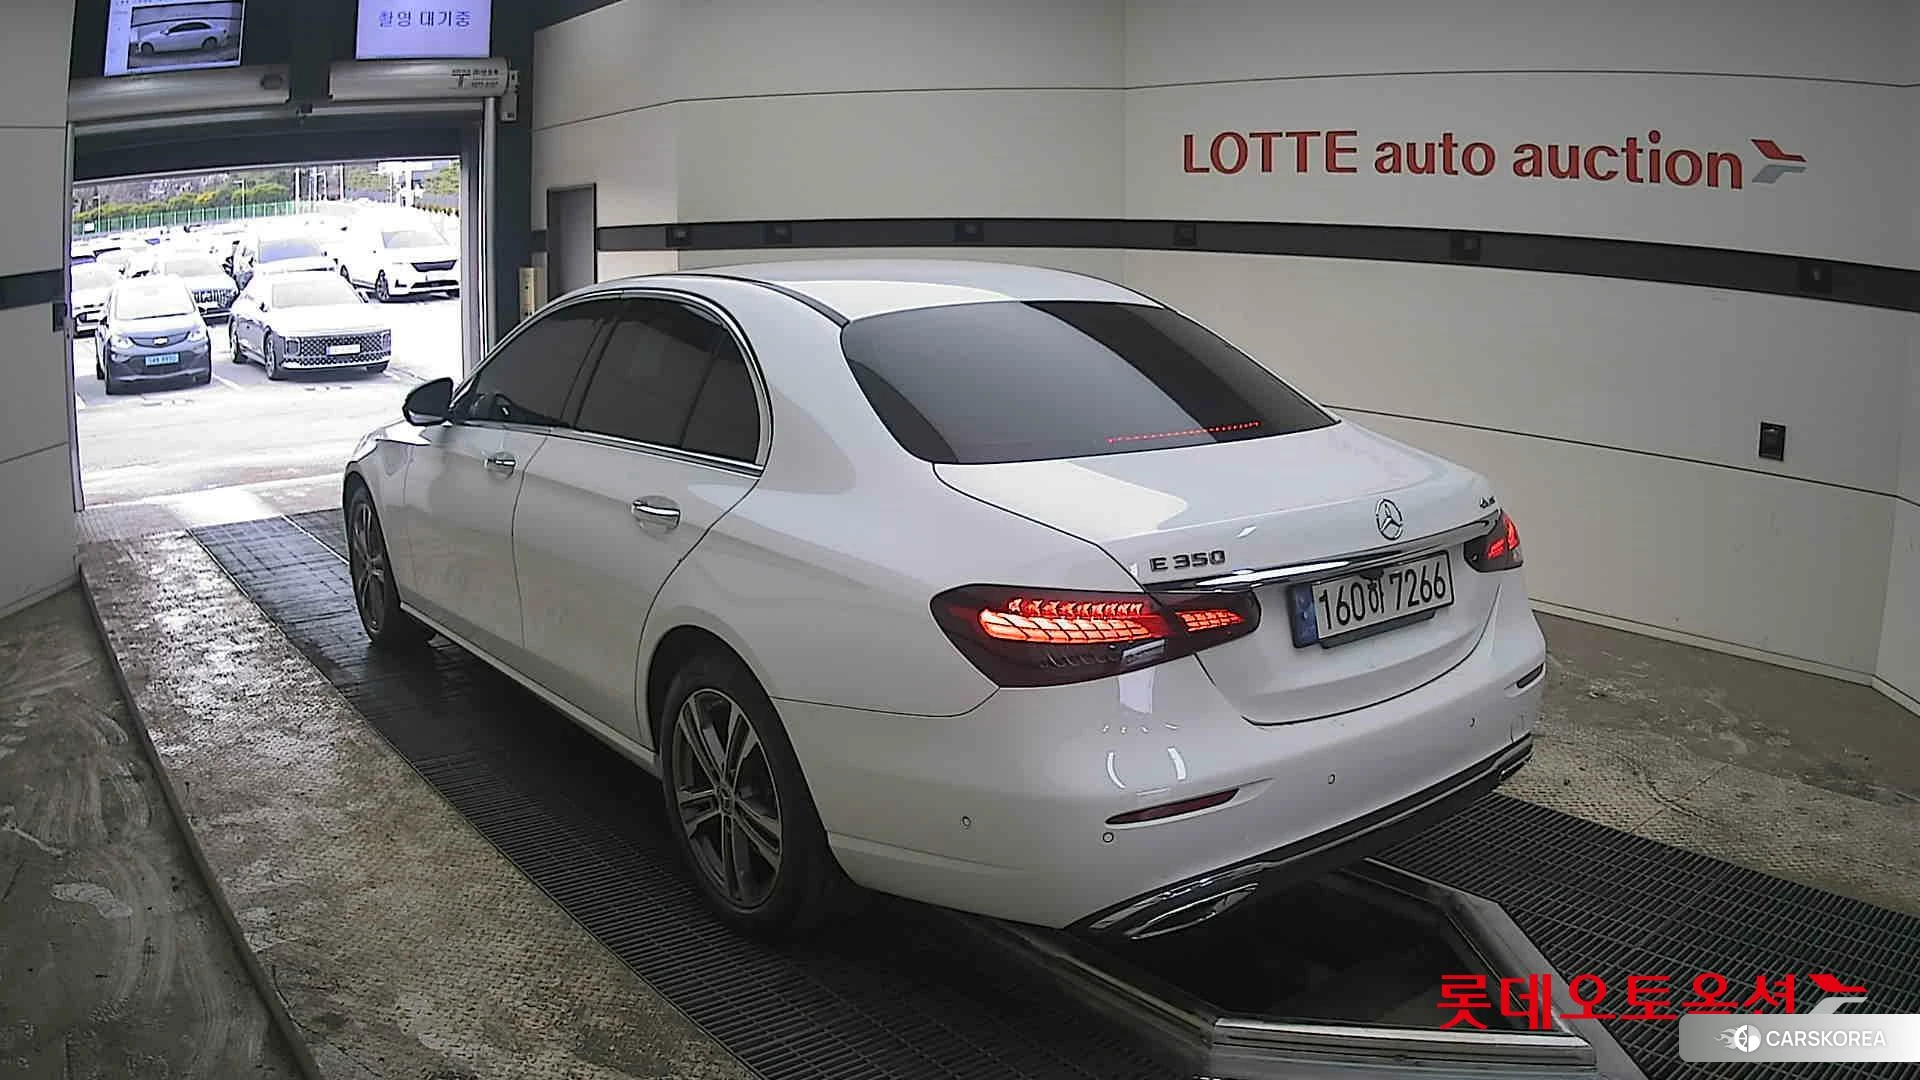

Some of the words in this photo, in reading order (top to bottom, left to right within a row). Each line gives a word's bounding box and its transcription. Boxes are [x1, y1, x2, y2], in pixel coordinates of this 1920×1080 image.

[420, 10, 471, 27] 대기중
[1184, 130, 1358, 175] LOTTE
[1374, 132, 1496, 176] auto
[1512, 129, 1743, 190] auction
[1149, 556, 1169, 572] E
[1172, 550, 1226, 569] 350
[1388, 561, 1446, 611] 7266
